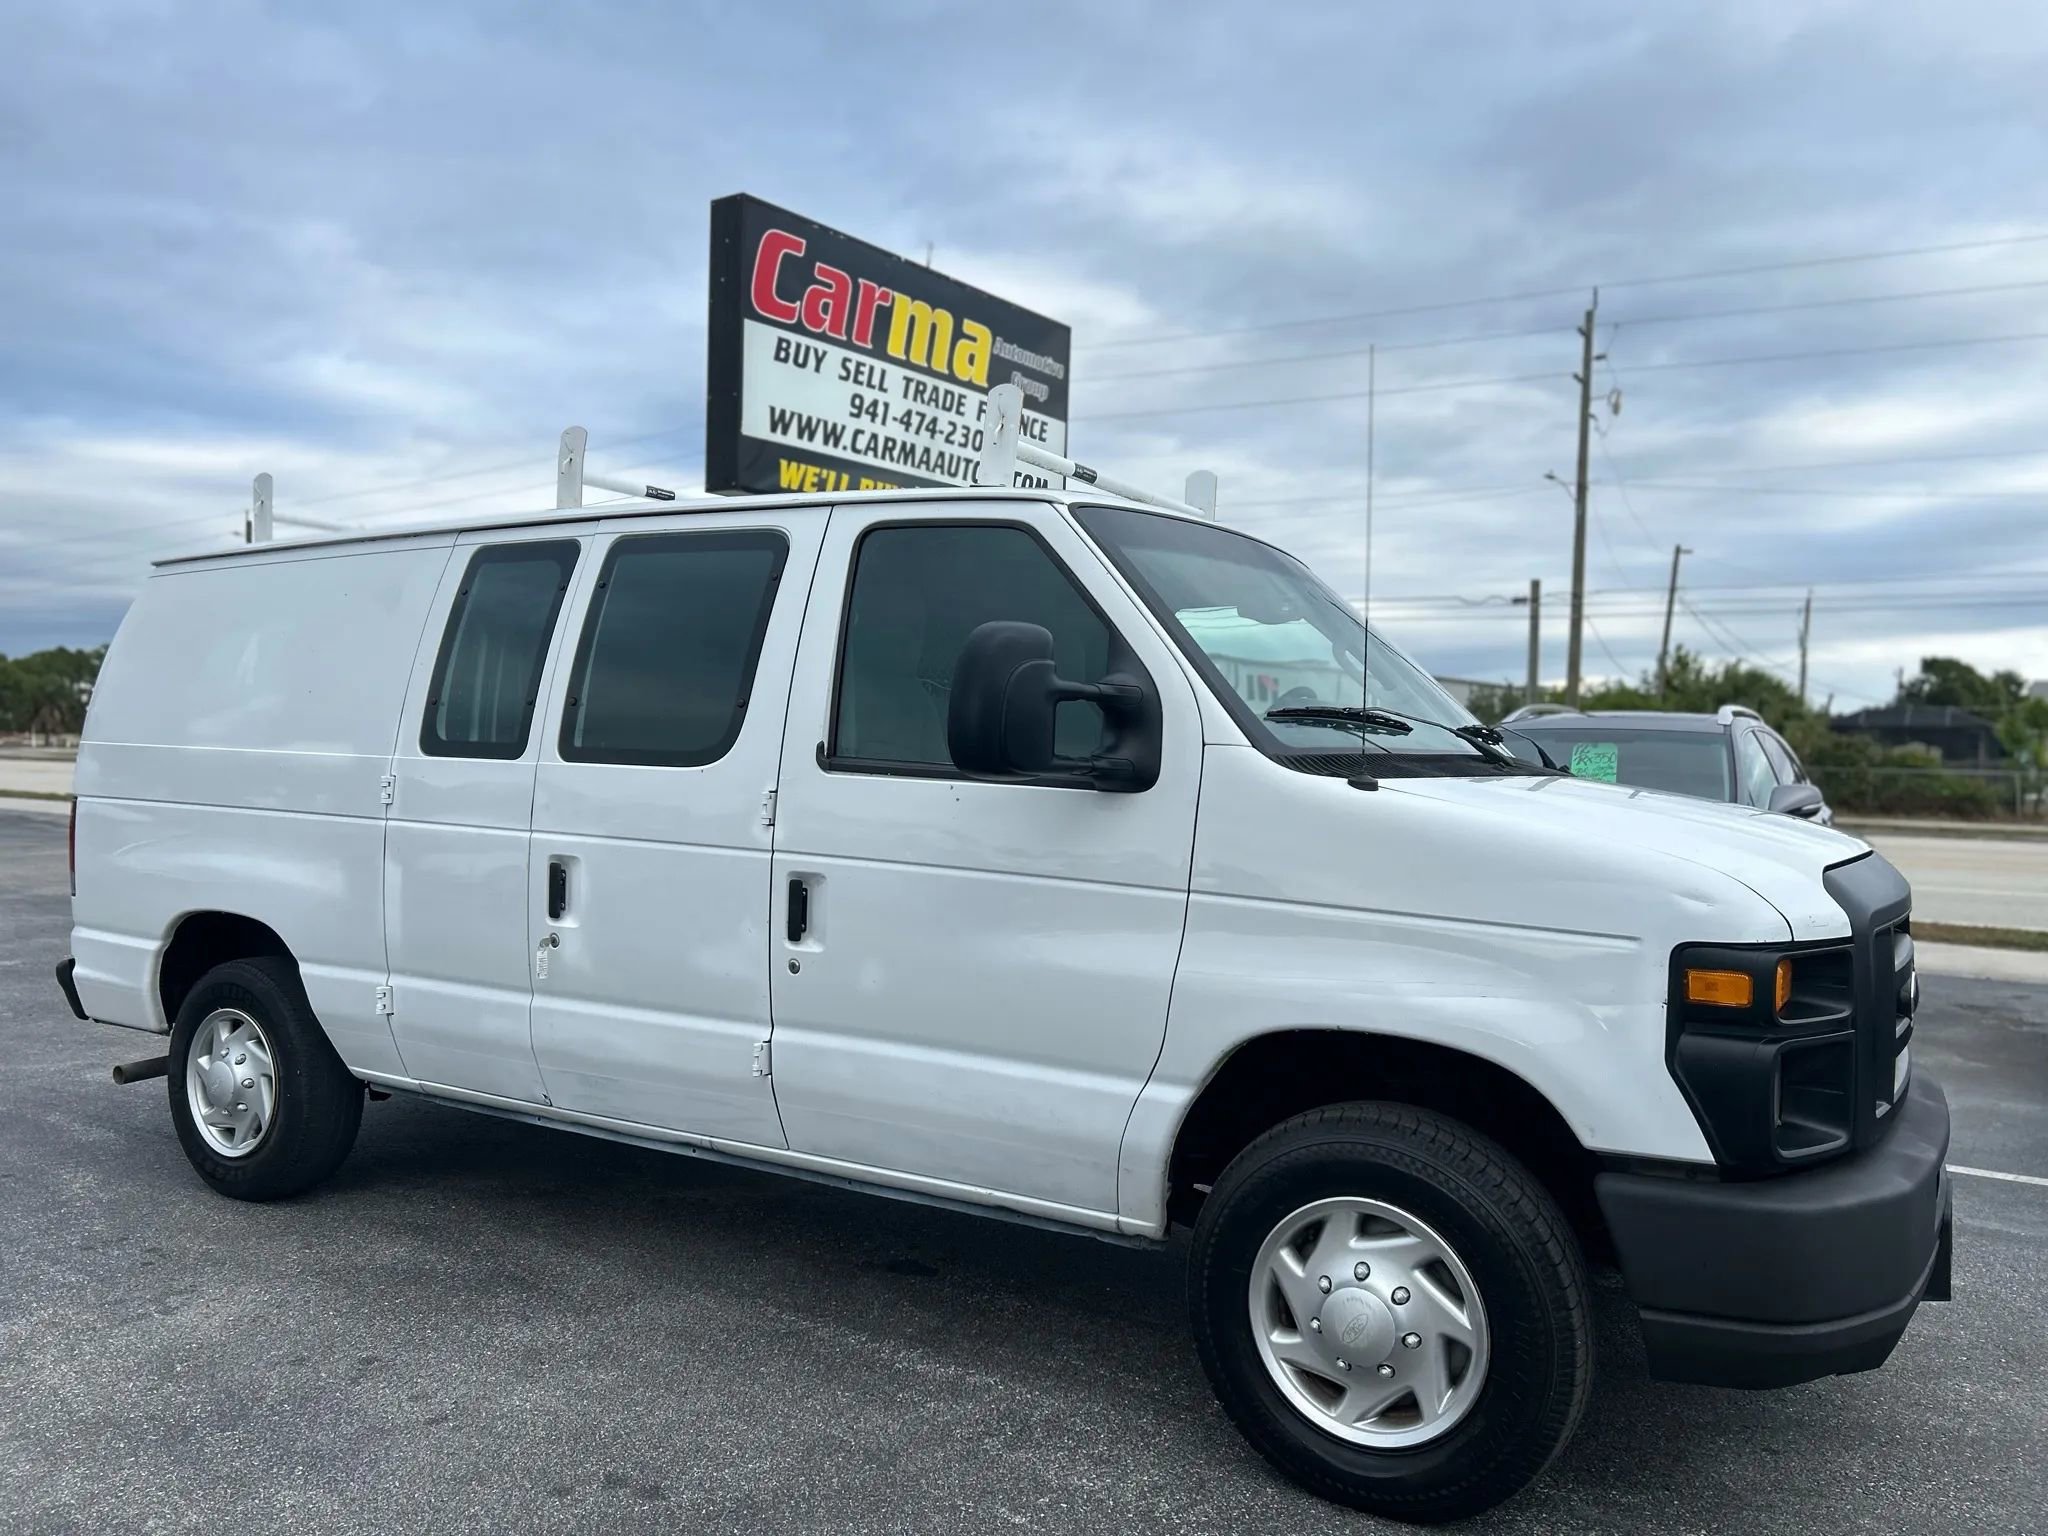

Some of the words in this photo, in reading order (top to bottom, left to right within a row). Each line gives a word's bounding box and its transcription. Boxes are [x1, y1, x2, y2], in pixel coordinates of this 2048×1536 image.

[751, 229, 993, 388] Carma
[773, 336, 827, 373] BUY
[838, 357, 888, 393] SELL
[902, 375, 967, 416] TRADE
[976, 400, 1049, 442] FNCE
[849, 393, 984, 452] 941-474-230
